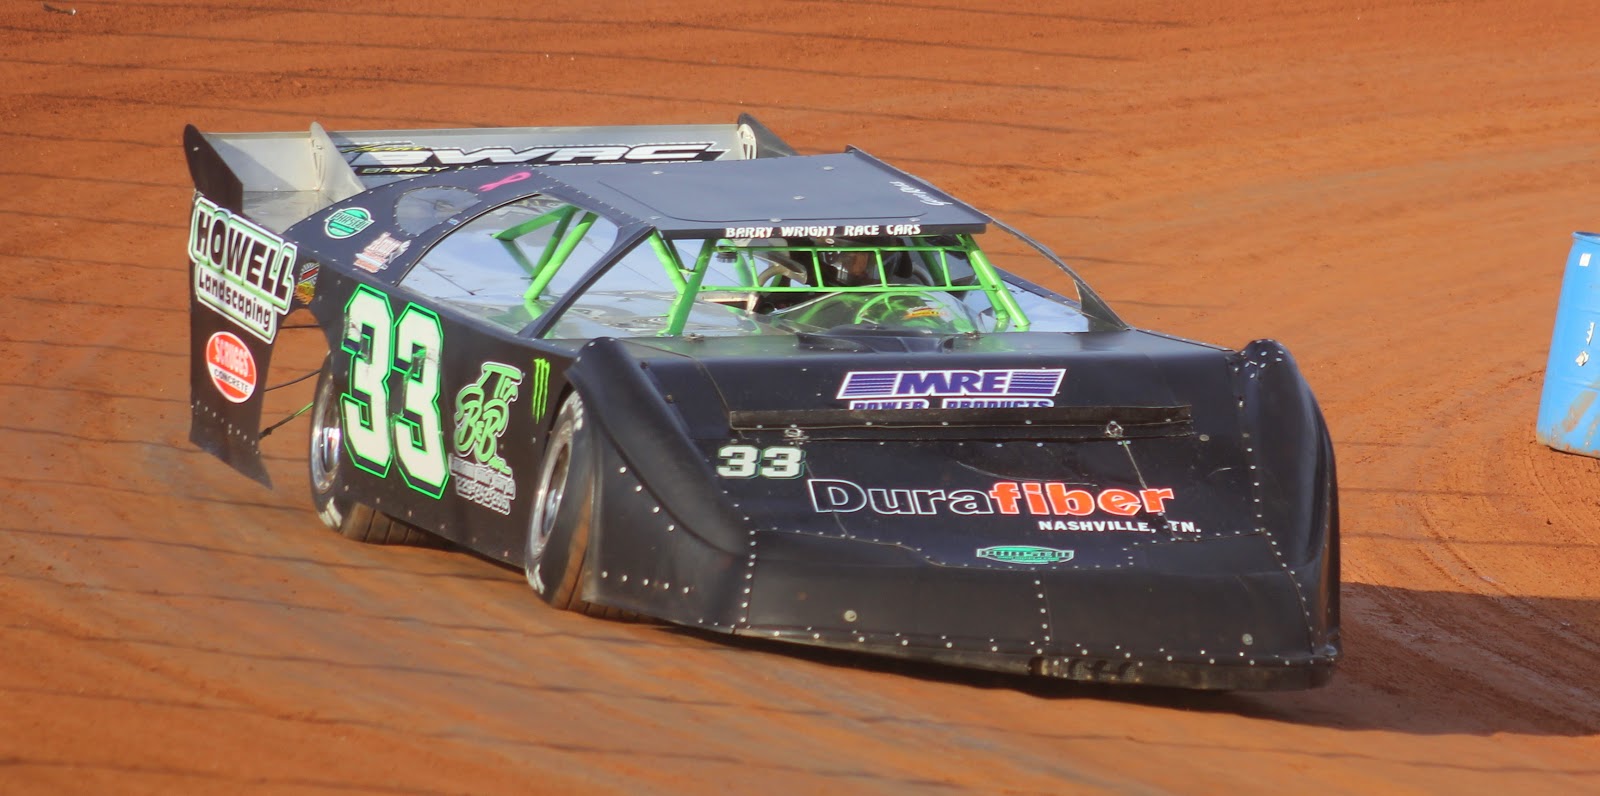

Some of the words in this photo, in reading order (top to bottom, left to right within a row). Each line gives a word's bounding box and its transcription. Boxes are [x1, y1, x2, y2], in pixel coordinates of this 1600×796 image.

[725, 227, 773, 238] BARRY
[781, 225, 837, 237] WRIGHT
[844, 225, 880, 236] RACE
[886, 224, 921, 236] CARS
[193, 207, 293, 302] HOWELL
[199, 276, 271, 332] Landscaping
[213, 368, 250, 394] CONCRETE
[340, 283, 449, 500] 33
[899, 371, 1010, 395] MRE
[718, 445, 805, 479] 33
[1038, 520, 1157, 534] NASHVILLE,
